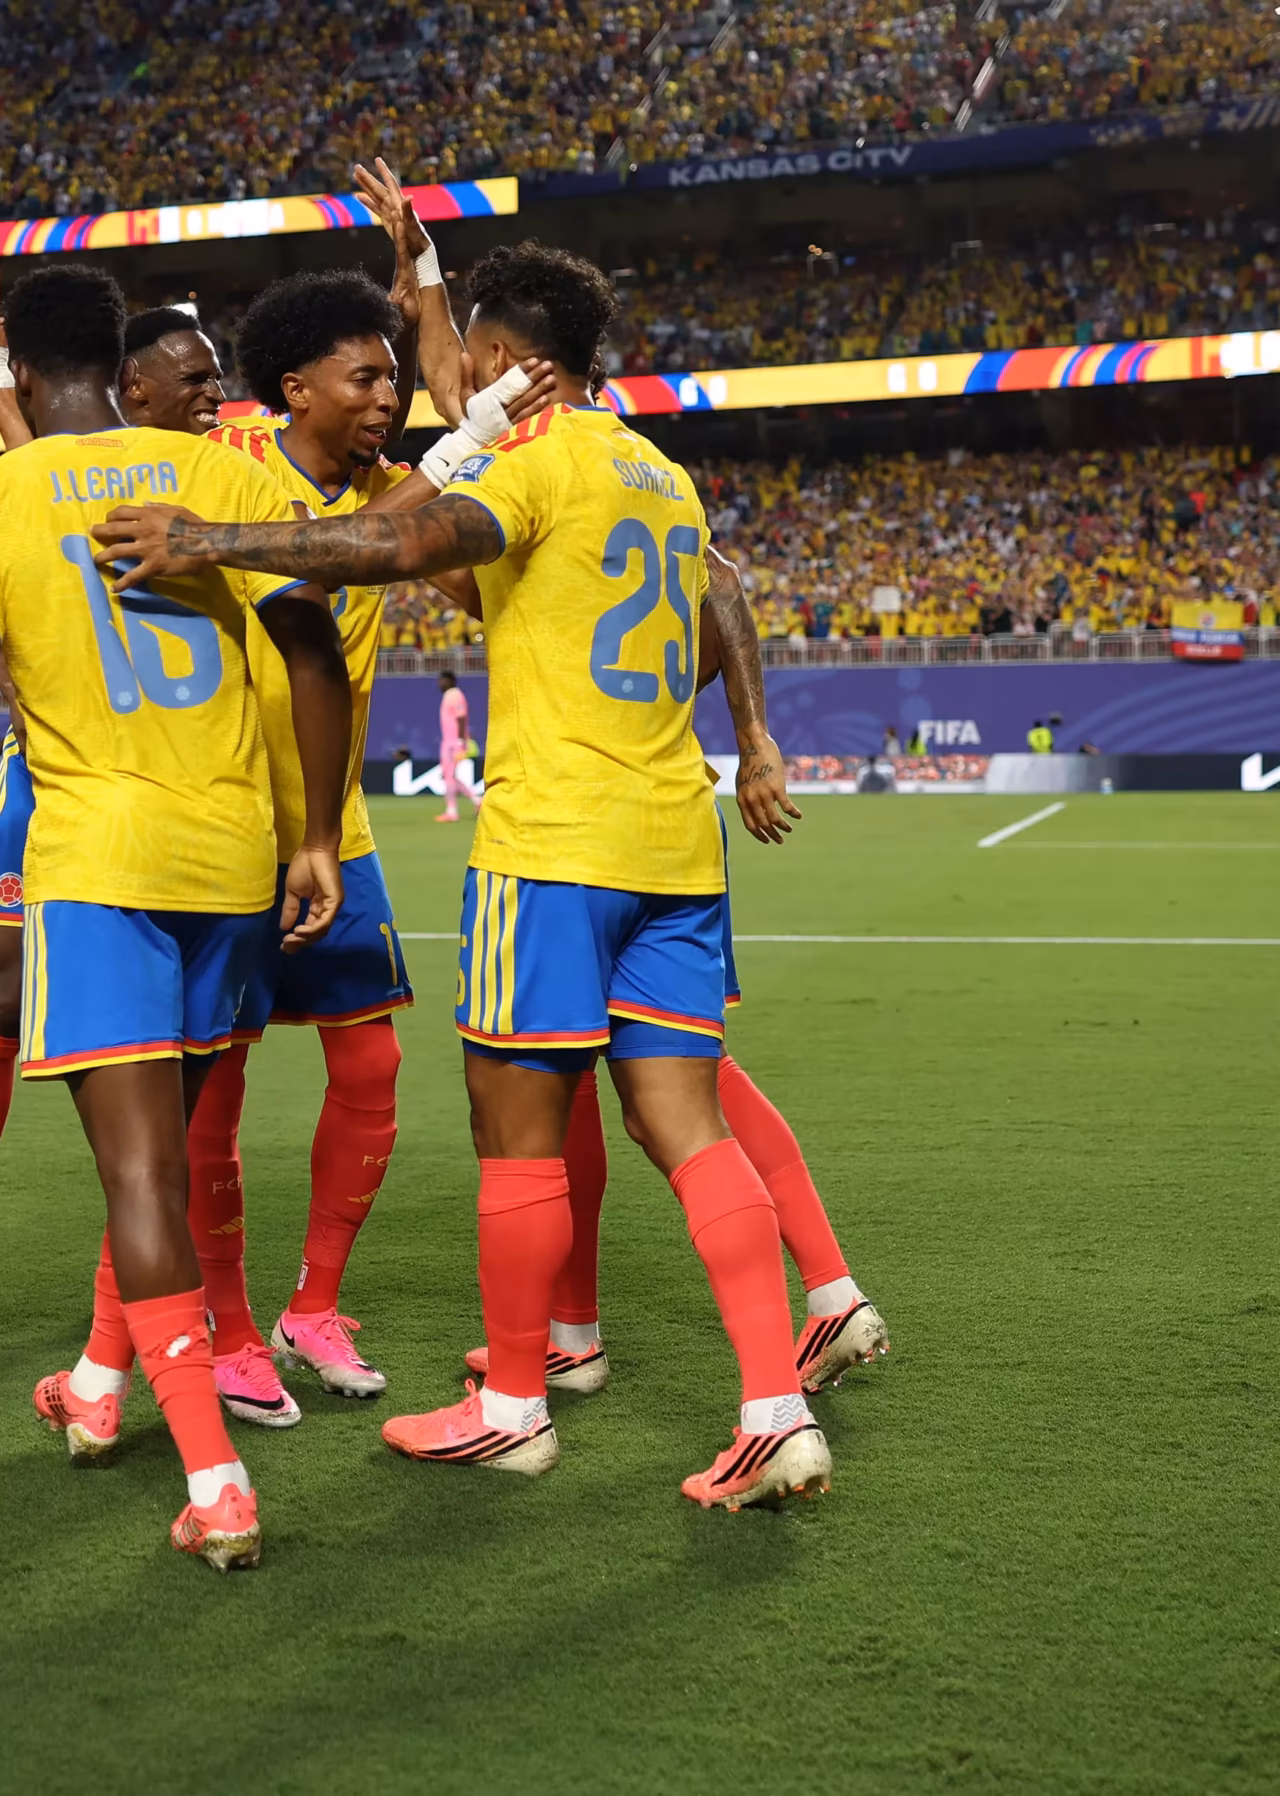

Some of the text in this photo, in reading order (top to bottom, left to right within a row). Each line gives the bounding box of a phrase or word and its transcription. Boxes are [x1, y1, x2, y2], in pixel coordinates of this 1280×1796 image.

[669, 146, 913, 186] KANSAS CITY
[50, 461, 179, 503] J.LERMA
[60, 534, 223, 715] 16
[590, 518, 700, 704] 25
[918, 720, 982, 745] FIFA
